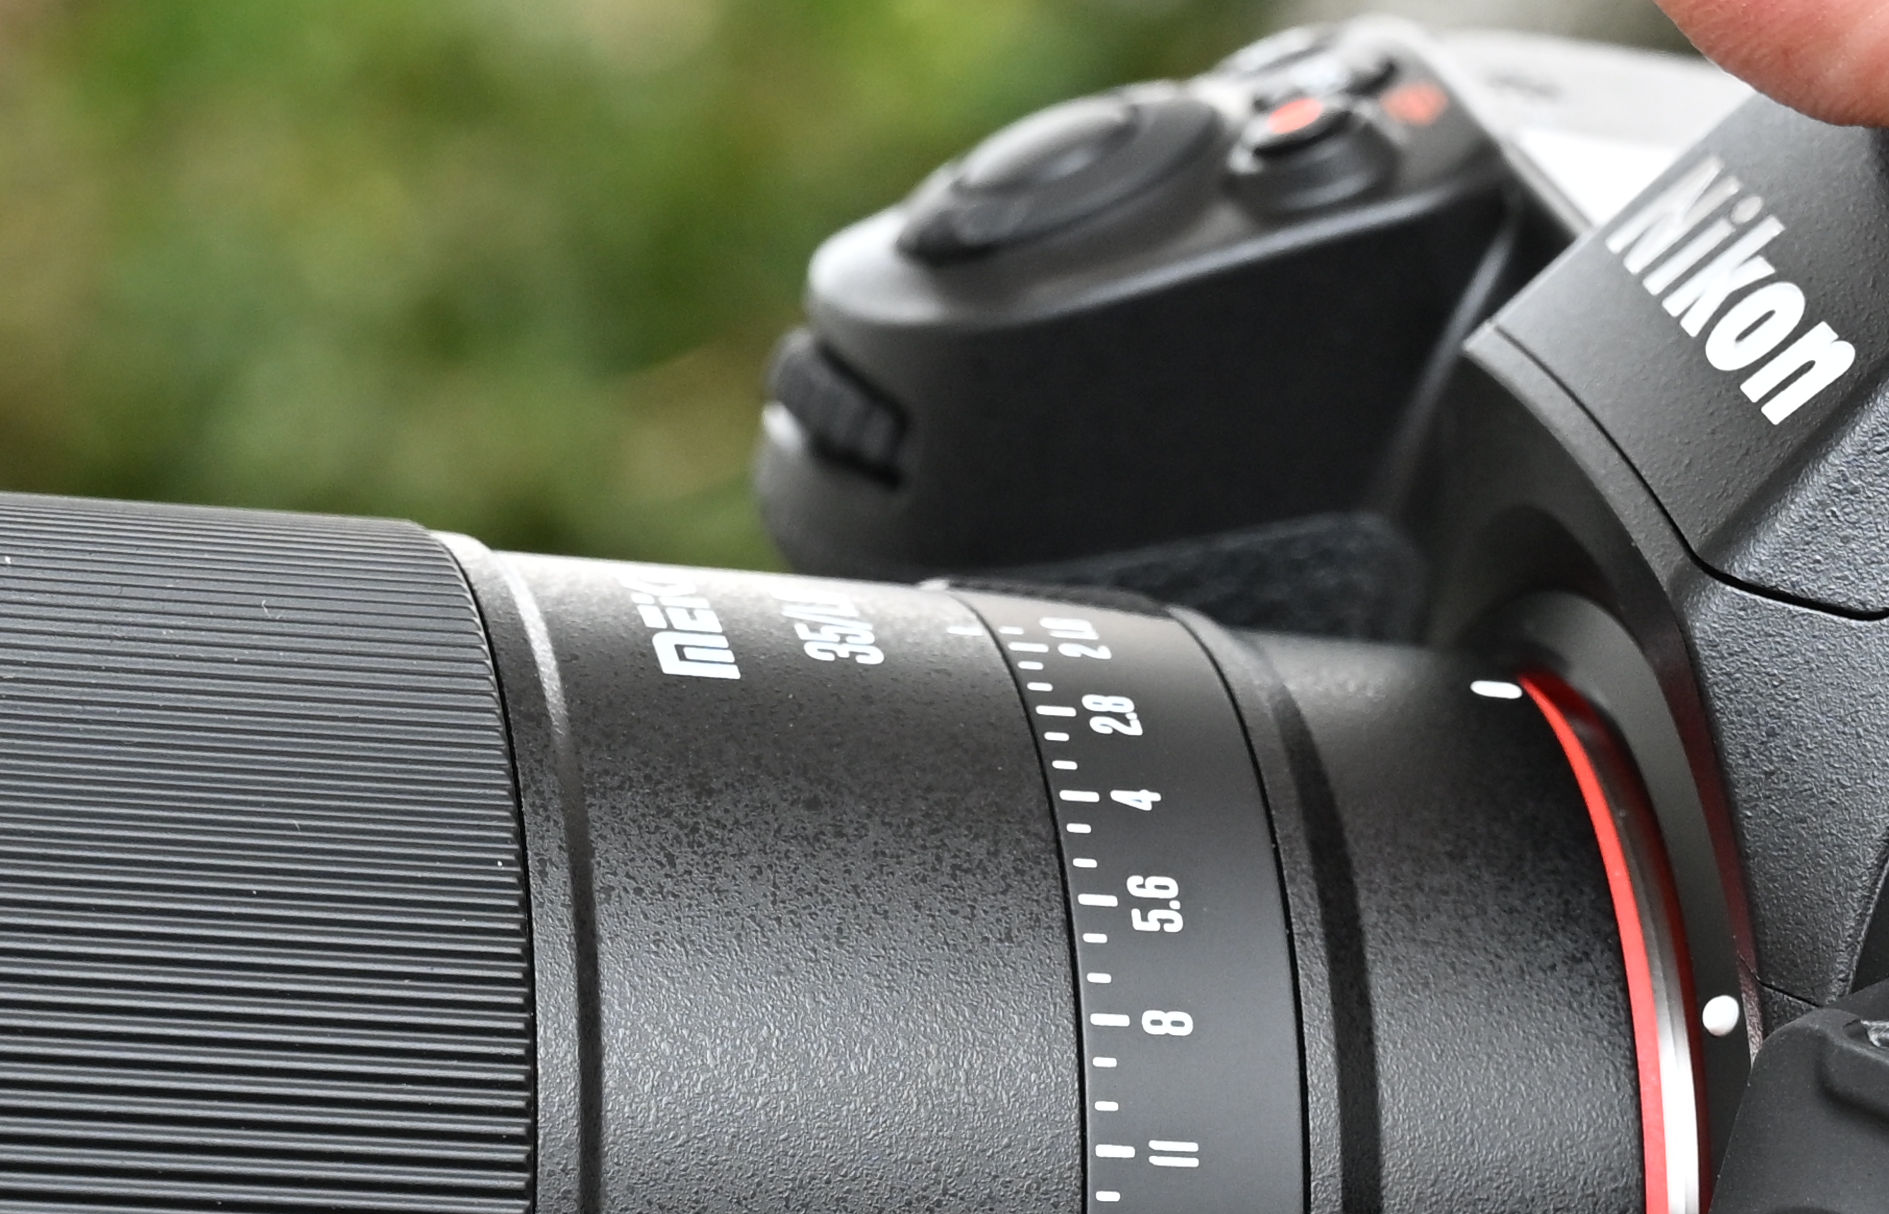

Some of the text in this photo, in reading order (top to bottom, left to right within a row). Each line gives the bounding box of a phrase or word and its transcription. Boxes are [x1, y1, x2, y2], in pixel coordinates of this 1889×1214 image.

[1605, 156, 1856, 425] Nikon
[1081, 694, 1143, 736] 2.8
[1110, 789, 1162, 812] 4
[1126, 874, 1184, 933] 5.6
[1141, 1009, 1194, 1037] 8
[1147, 1139, 1200, 1168] 11
